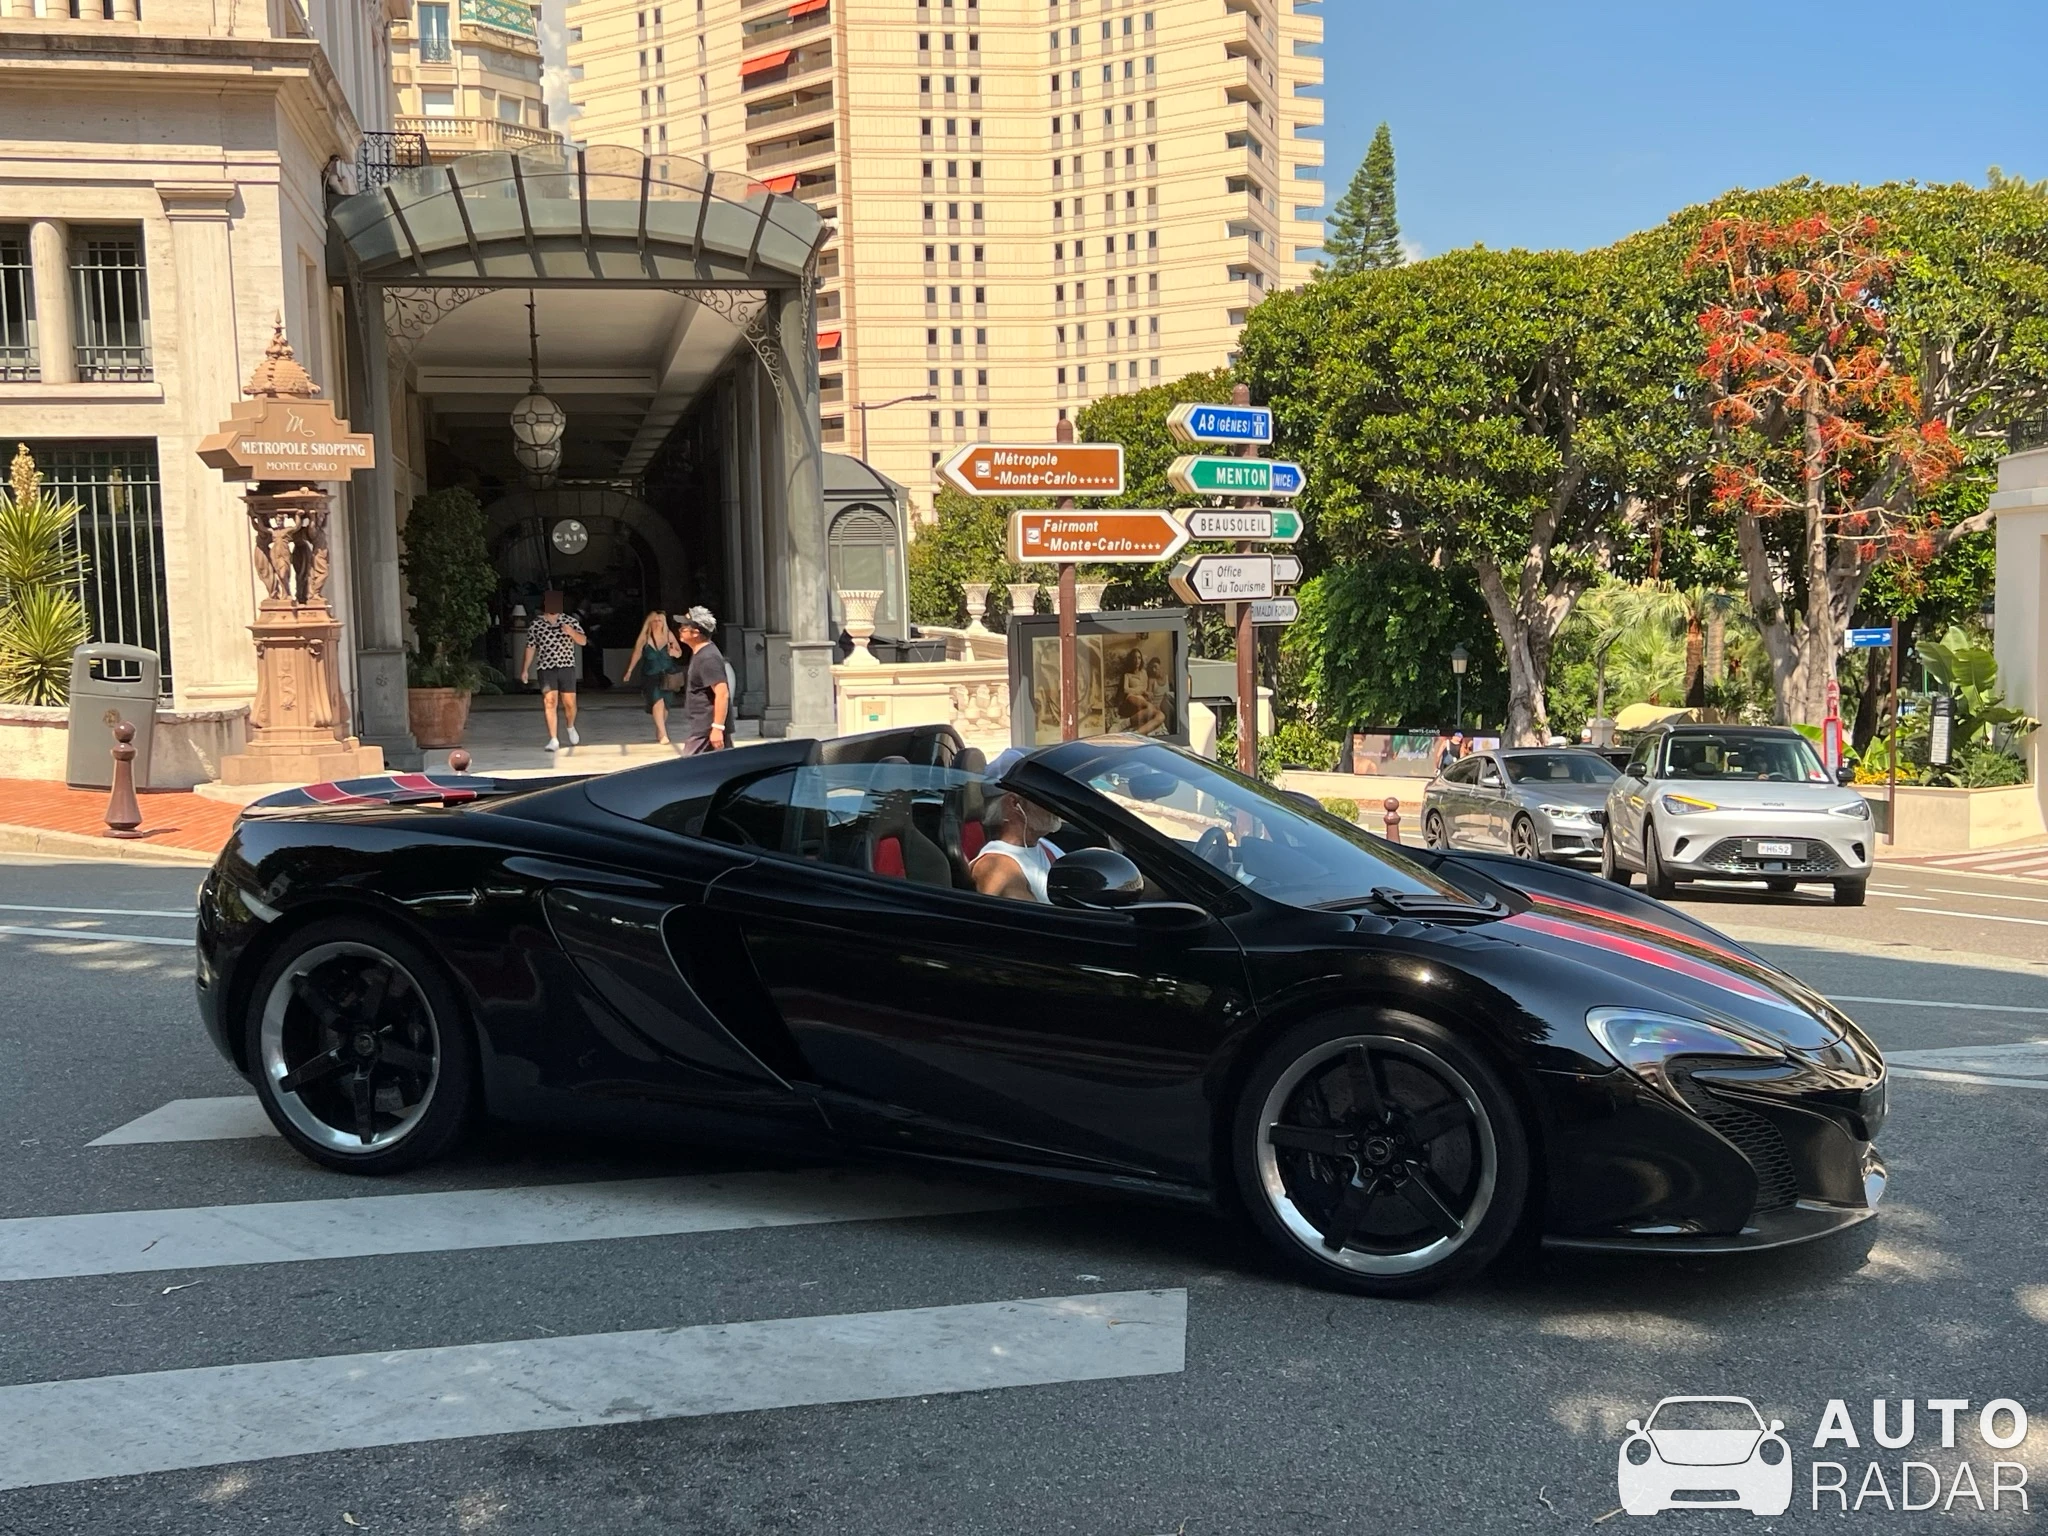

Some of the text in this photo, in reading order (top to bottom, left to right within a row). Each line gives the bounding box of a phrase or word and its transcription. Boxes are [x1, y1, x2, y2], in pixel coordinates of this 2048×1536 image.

[1198, 413, 1251, 435] A8 (GÊNES)
[241, 441, 366, 456] METROPOLE SHOPPING
[266, 461, 338, 472] MONTE CARLO
[993, 452, 1058, 469] Métropole
[1216, 467, 1267, 486] MENTON
[1043, 518, 1099, 533] Fairmont
[1200, 518, 1267, 532] BEAUSOLEIL
[1217, 565, 1242, 578] Office
[1217, 581, 1266, 593] du Tourisme
